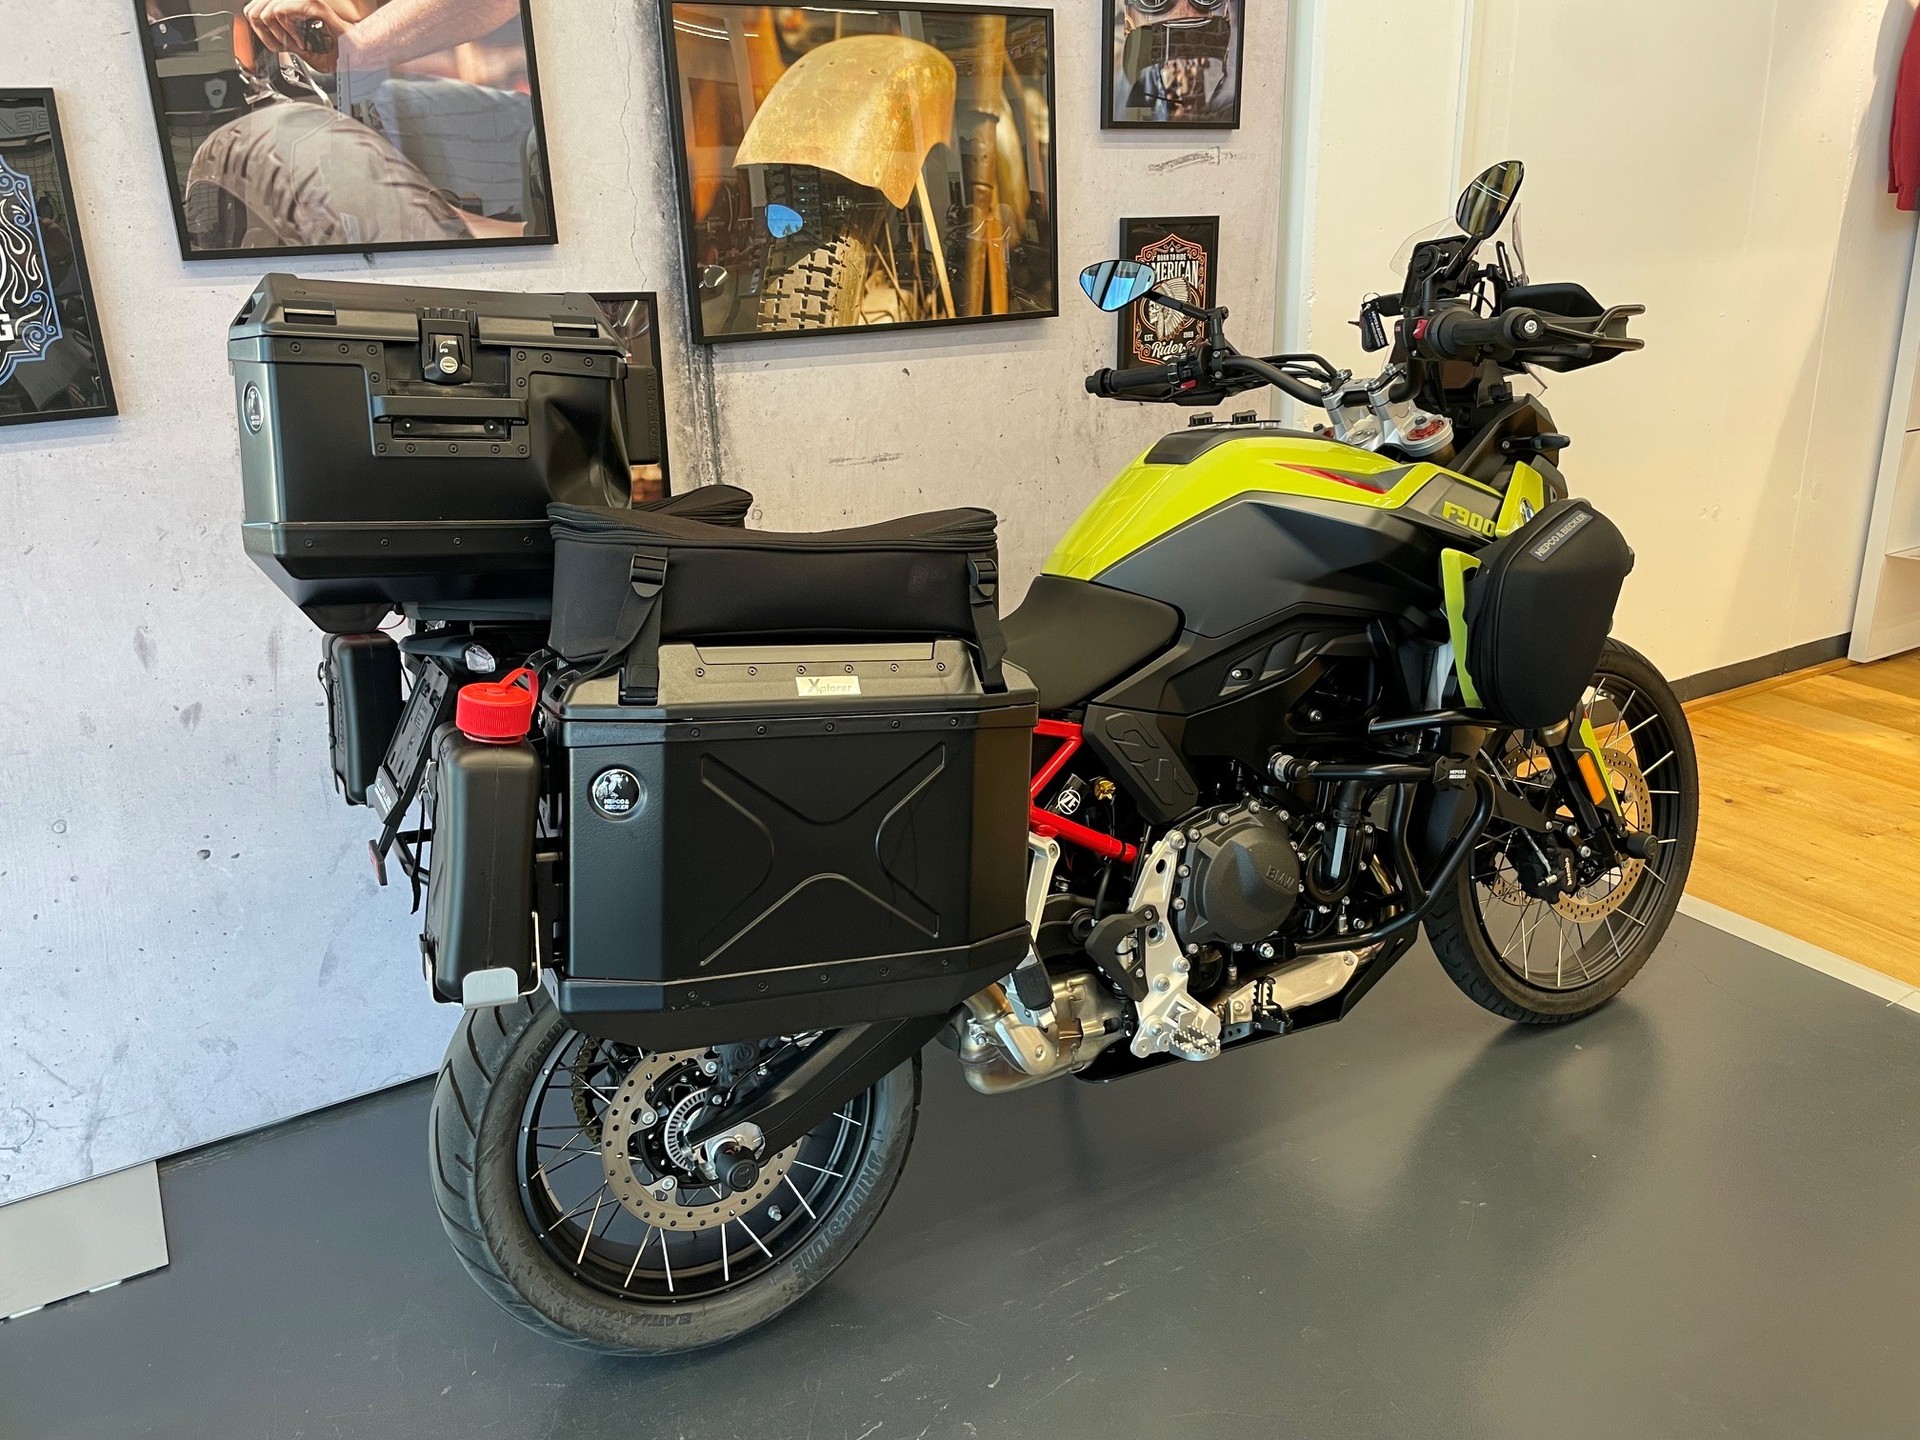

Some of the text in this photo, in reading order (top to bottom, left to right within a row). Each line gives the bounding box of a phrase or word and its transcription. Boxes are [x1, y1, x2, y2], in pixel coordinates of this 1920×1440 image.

[1149, 260, 1199, 289] MERICAN
[1152, 341, 1185, 358] Rider
[1442, 500, 1496, 538] F900
[808, 678, 853, 694] Xplorer
[1265, 863, 1296, 889] BMW
[790, 1149, 885, 1277] BRIDGESTONE
